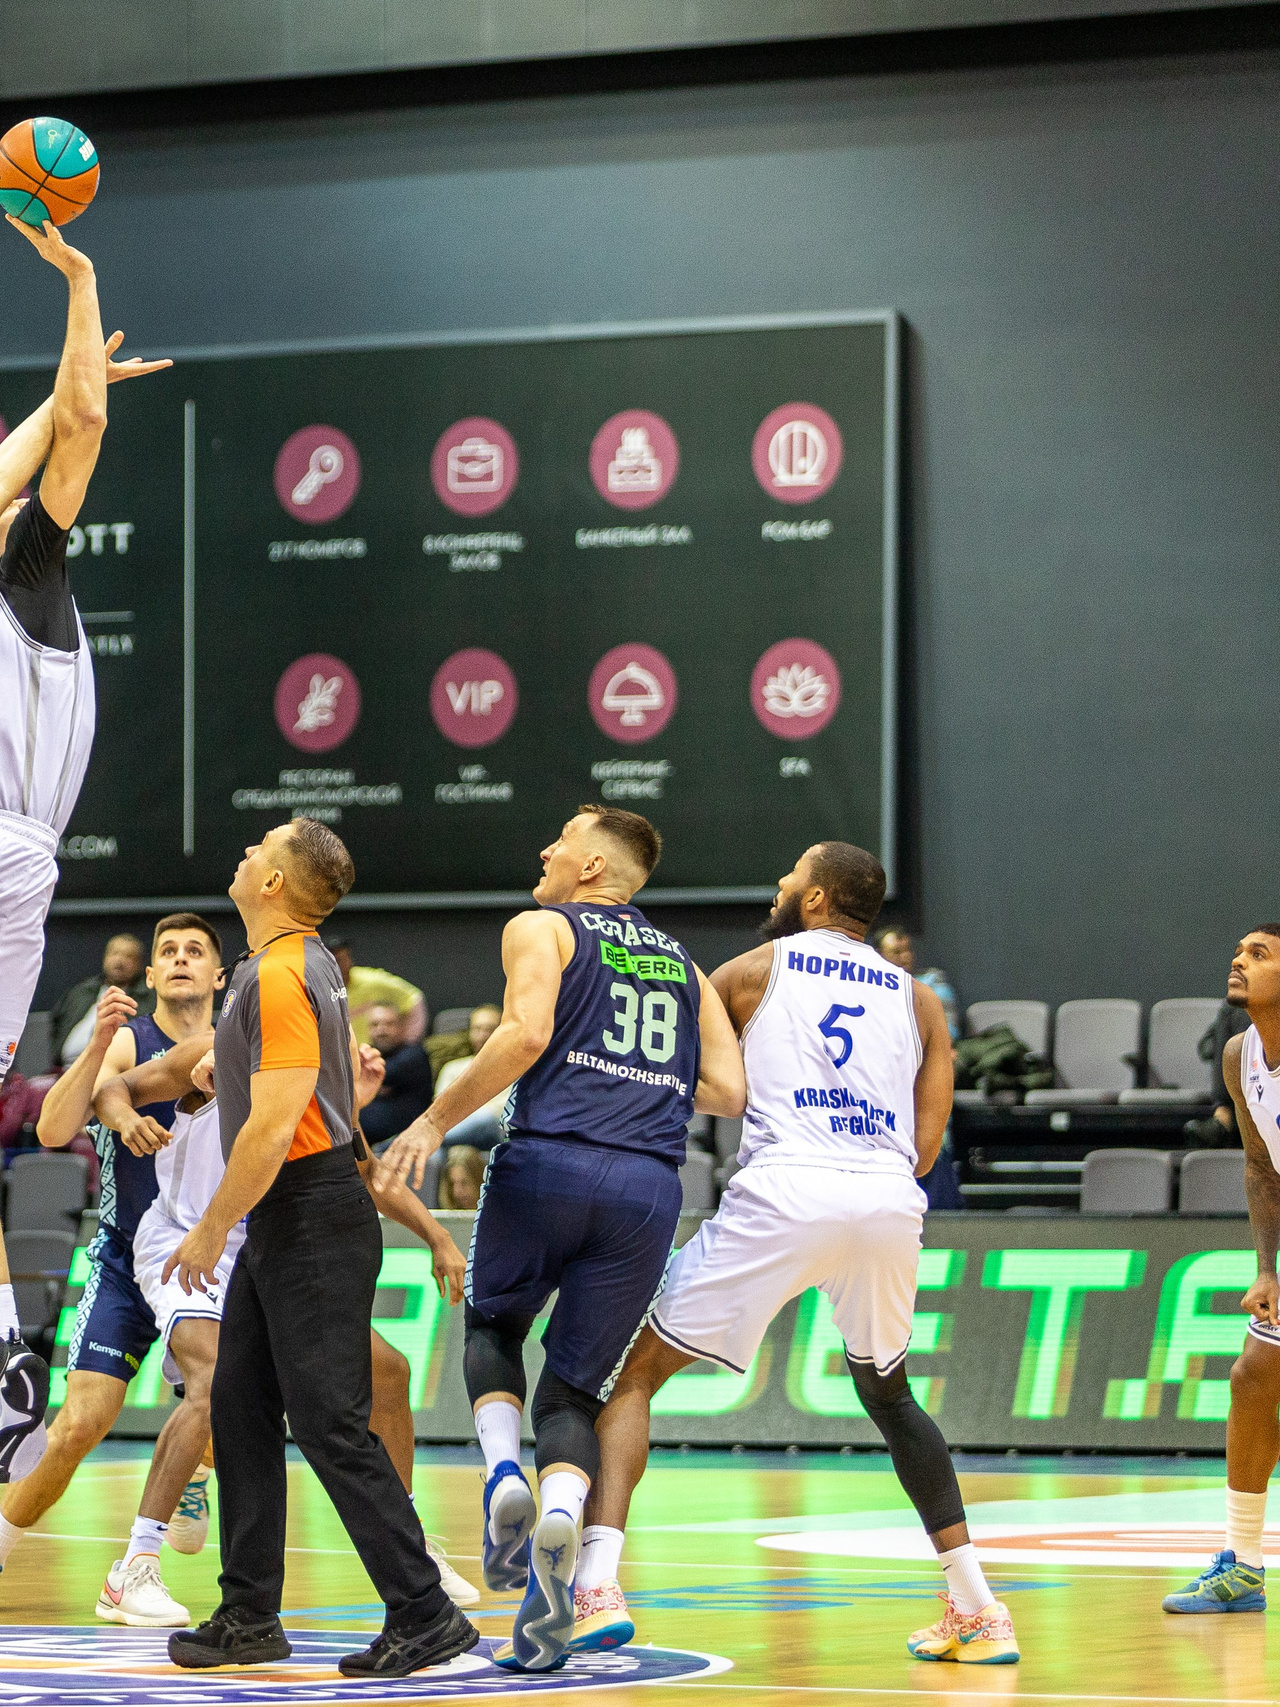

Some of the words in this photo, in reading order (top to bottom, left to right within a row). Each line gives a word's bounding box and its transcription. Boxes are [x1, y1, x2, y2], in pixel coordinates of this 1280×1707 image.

[445, 679, 504, 717] VIP
[787, 951, 900, 991] HOPKINS
[602, 981, 679, 1064] 38
[817, 1003, 866, 1070] 5
[88, 1341, 123, 1358] Kempa
[242, 1673, 594, 1698] UNITED
